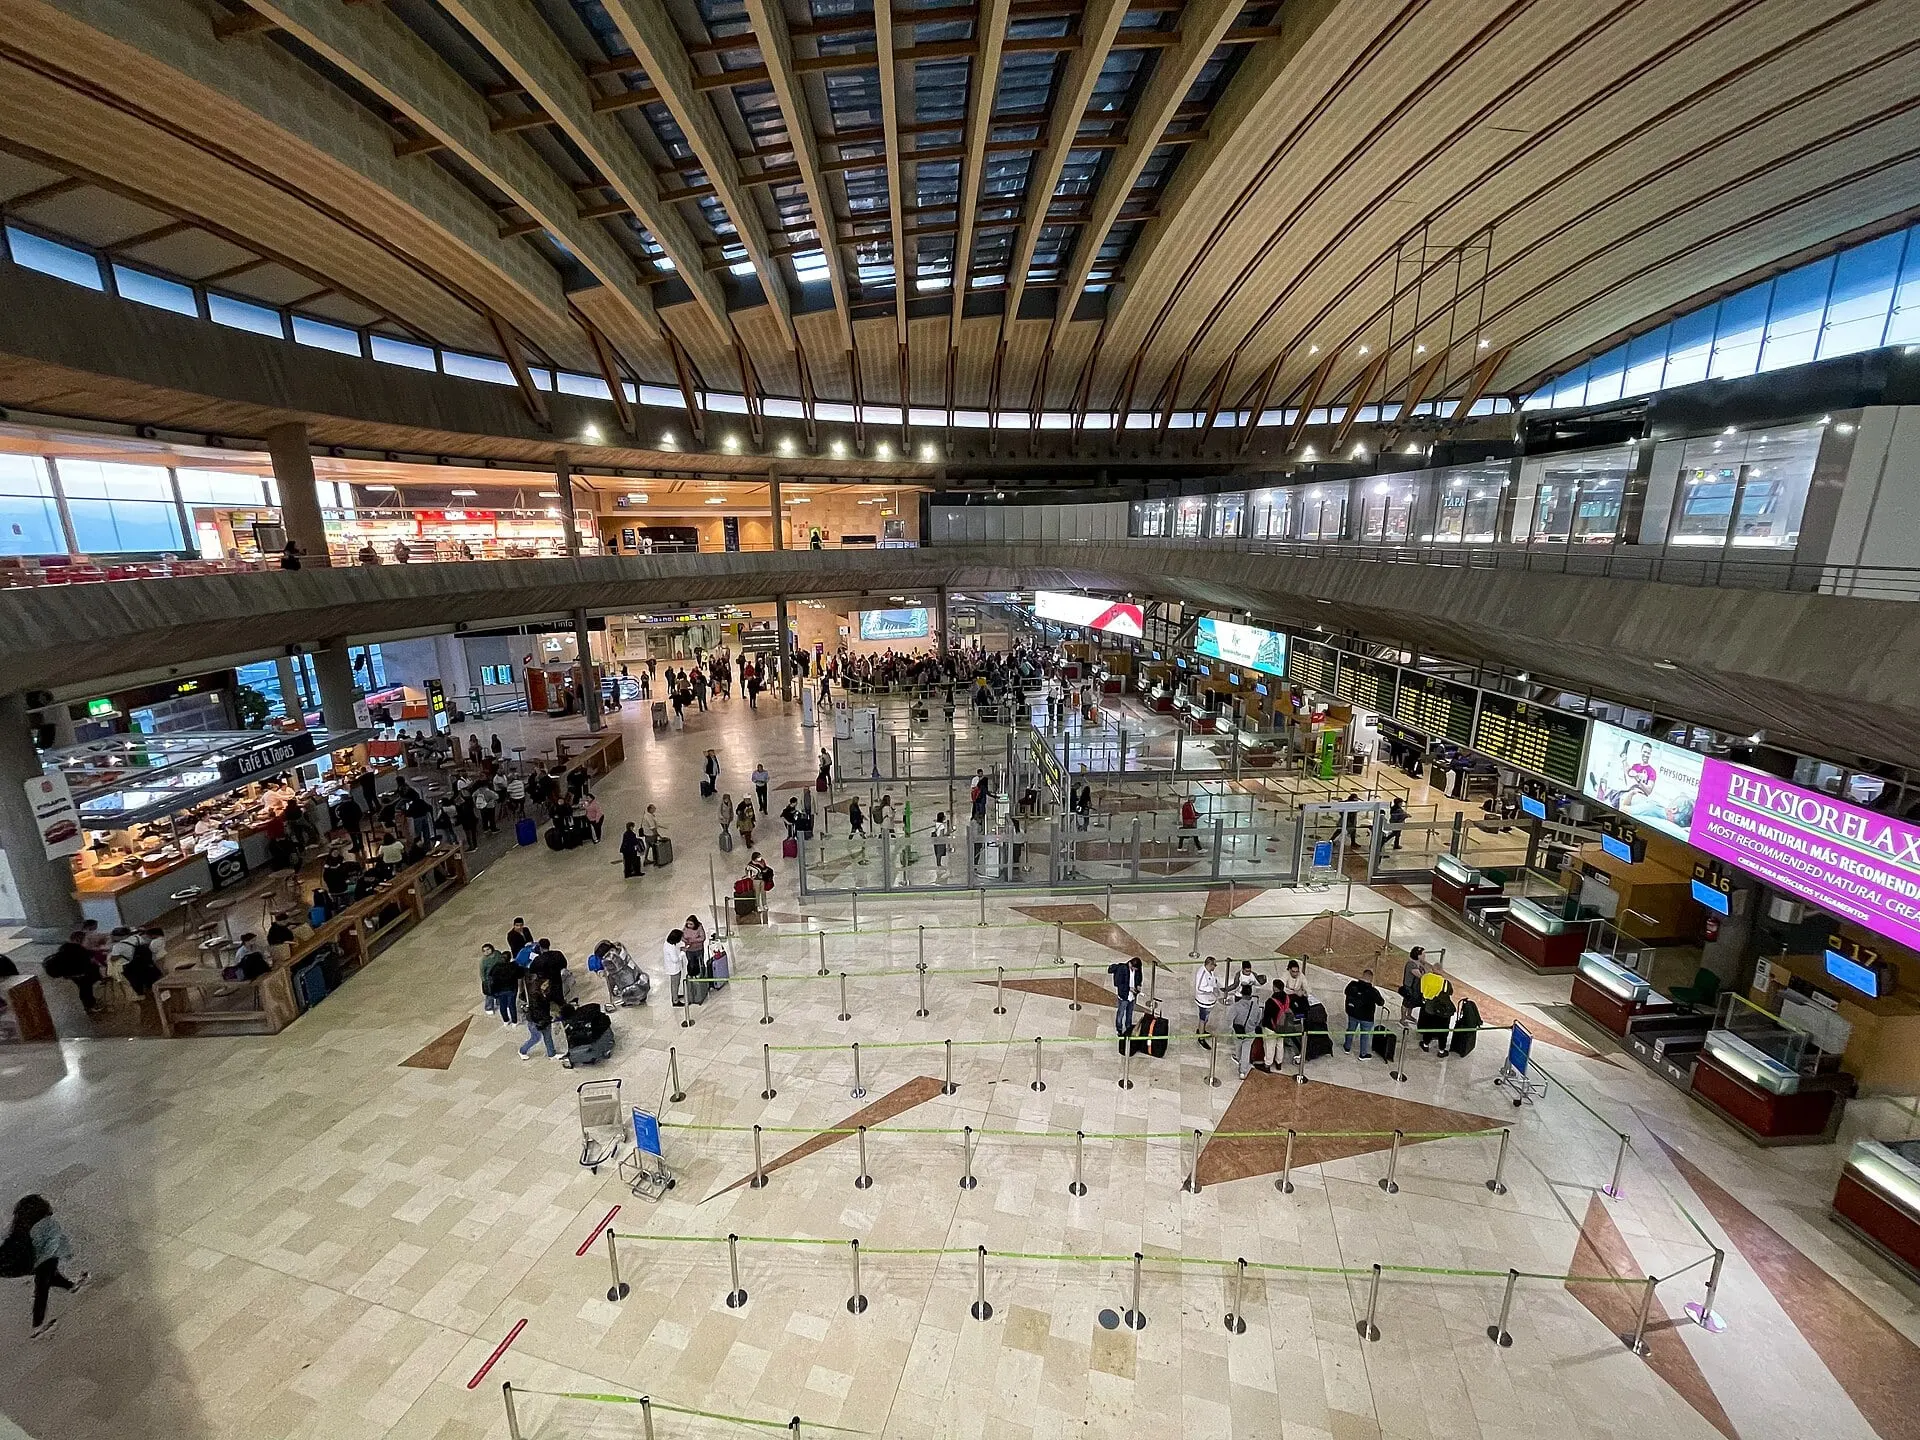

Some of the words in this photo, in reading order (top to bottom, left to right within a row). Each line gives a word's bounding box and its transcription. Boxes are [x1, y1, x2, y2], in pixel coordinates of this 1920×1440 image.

[238, 751, 262, 774] Café
[262, 750, 272, 766] &
[269, 744, 295, 763] Tapas
[1535, 788, 1546, 804] 14
[1727, 773, 1920, 864] PHYSIORELAX
[1617, 826, 1634, 843] 15
[1708, 803, 1722, 819] LA
[1722, 807, 1757, 833] CREMA
[1757, 820, 1808, 854] NATURAL
[1809, 844, 1839, 866] MÁS
[1707, 822, 1738, 841] MOST
[1736, 834, 1822, 878] RECOMMENDED
[1823, 871, 1883, 906] NATURAL
[1710, 872, 1731, 893] 16
[1737, 856, 1762, 872] CREMA
[1759, 866, 1777, 880] PARA
[1776, 873, 1814, 894] MÚSCULOS
[1819, 892, 1869, 921] LIGAMENTOS
[1849, 943, 1878, 967] 17
